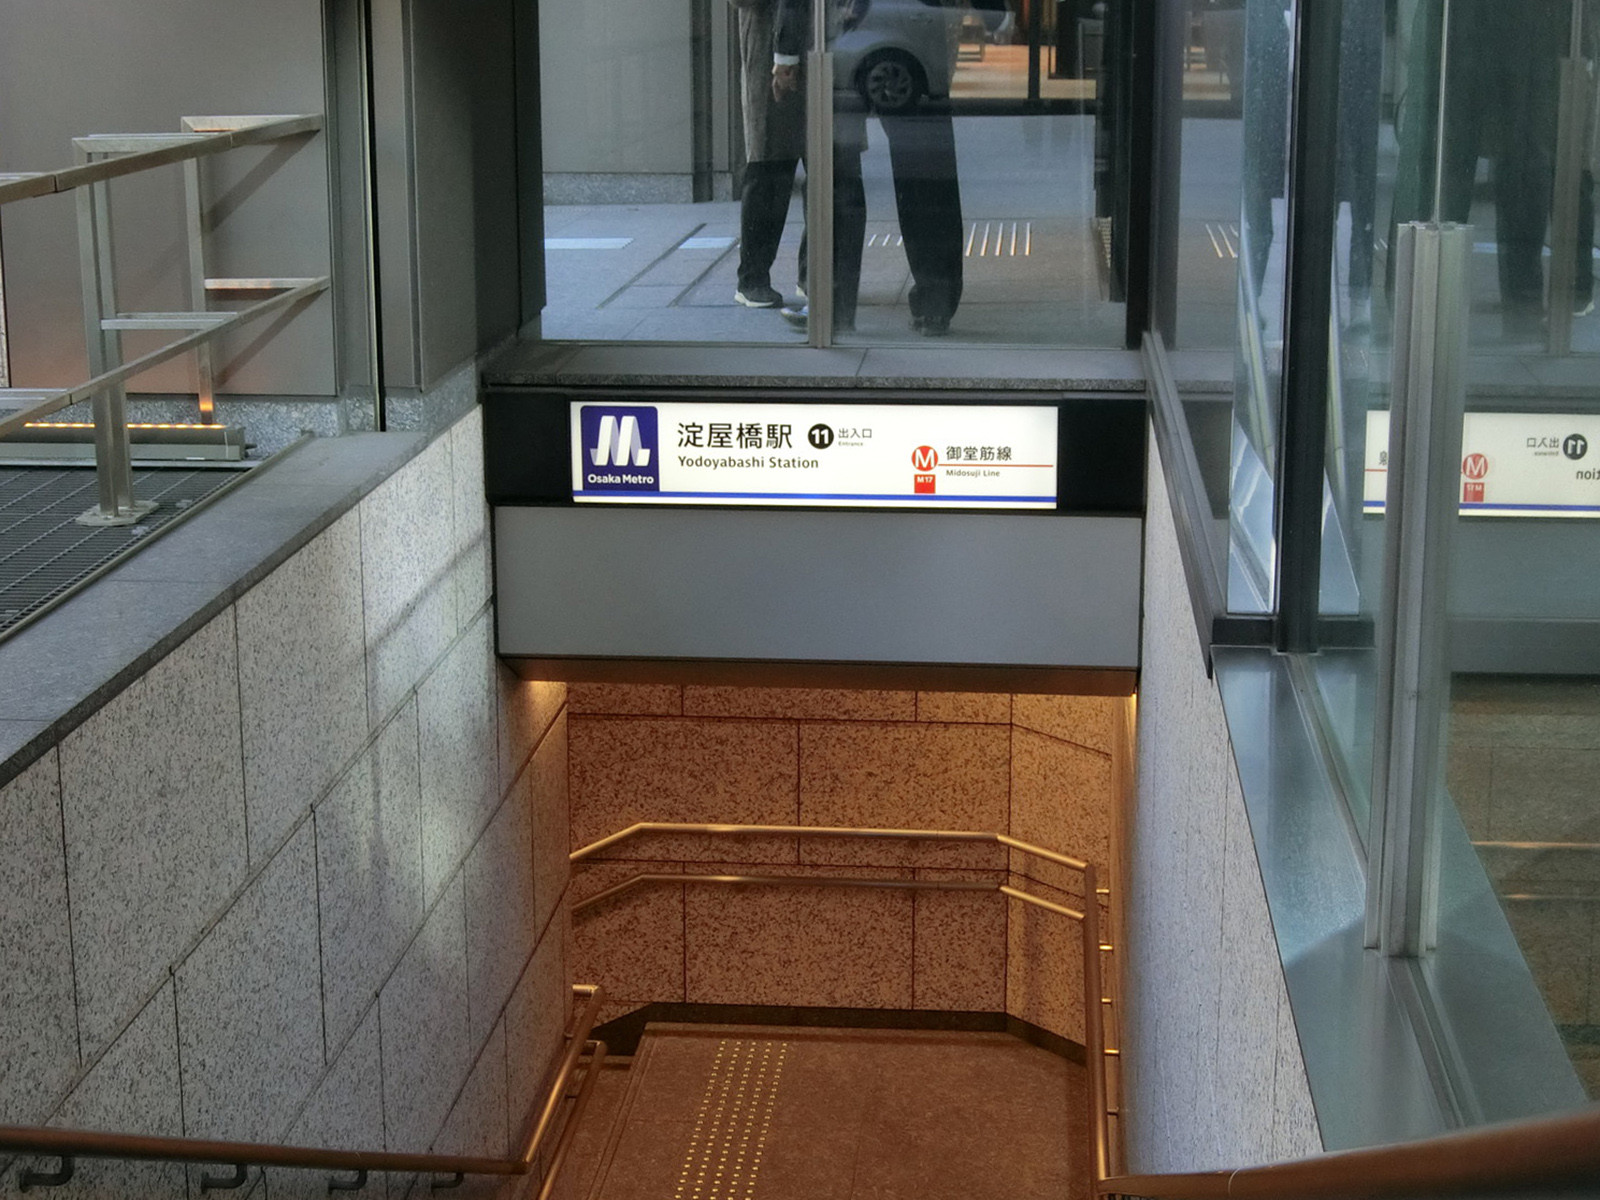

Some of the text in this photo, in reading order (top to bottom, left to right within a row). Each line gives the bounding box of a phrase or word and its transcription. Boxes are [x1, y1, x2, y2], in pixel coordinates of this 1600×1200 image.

[677, 422, 793, 449] 淀屋橋駅
[811, 428, 830, 445] 11
[838, 428, 873, 439] 出入口
[914, 449, 935, 468] M
[946, 446, 1012, 461] 御堂筋線
[678, 456, 819, 470] Yodoyabashi Station
[587, 473, 654, 485] Osaka Metro
[946, 469, 1000, 478] Midosuji Line
